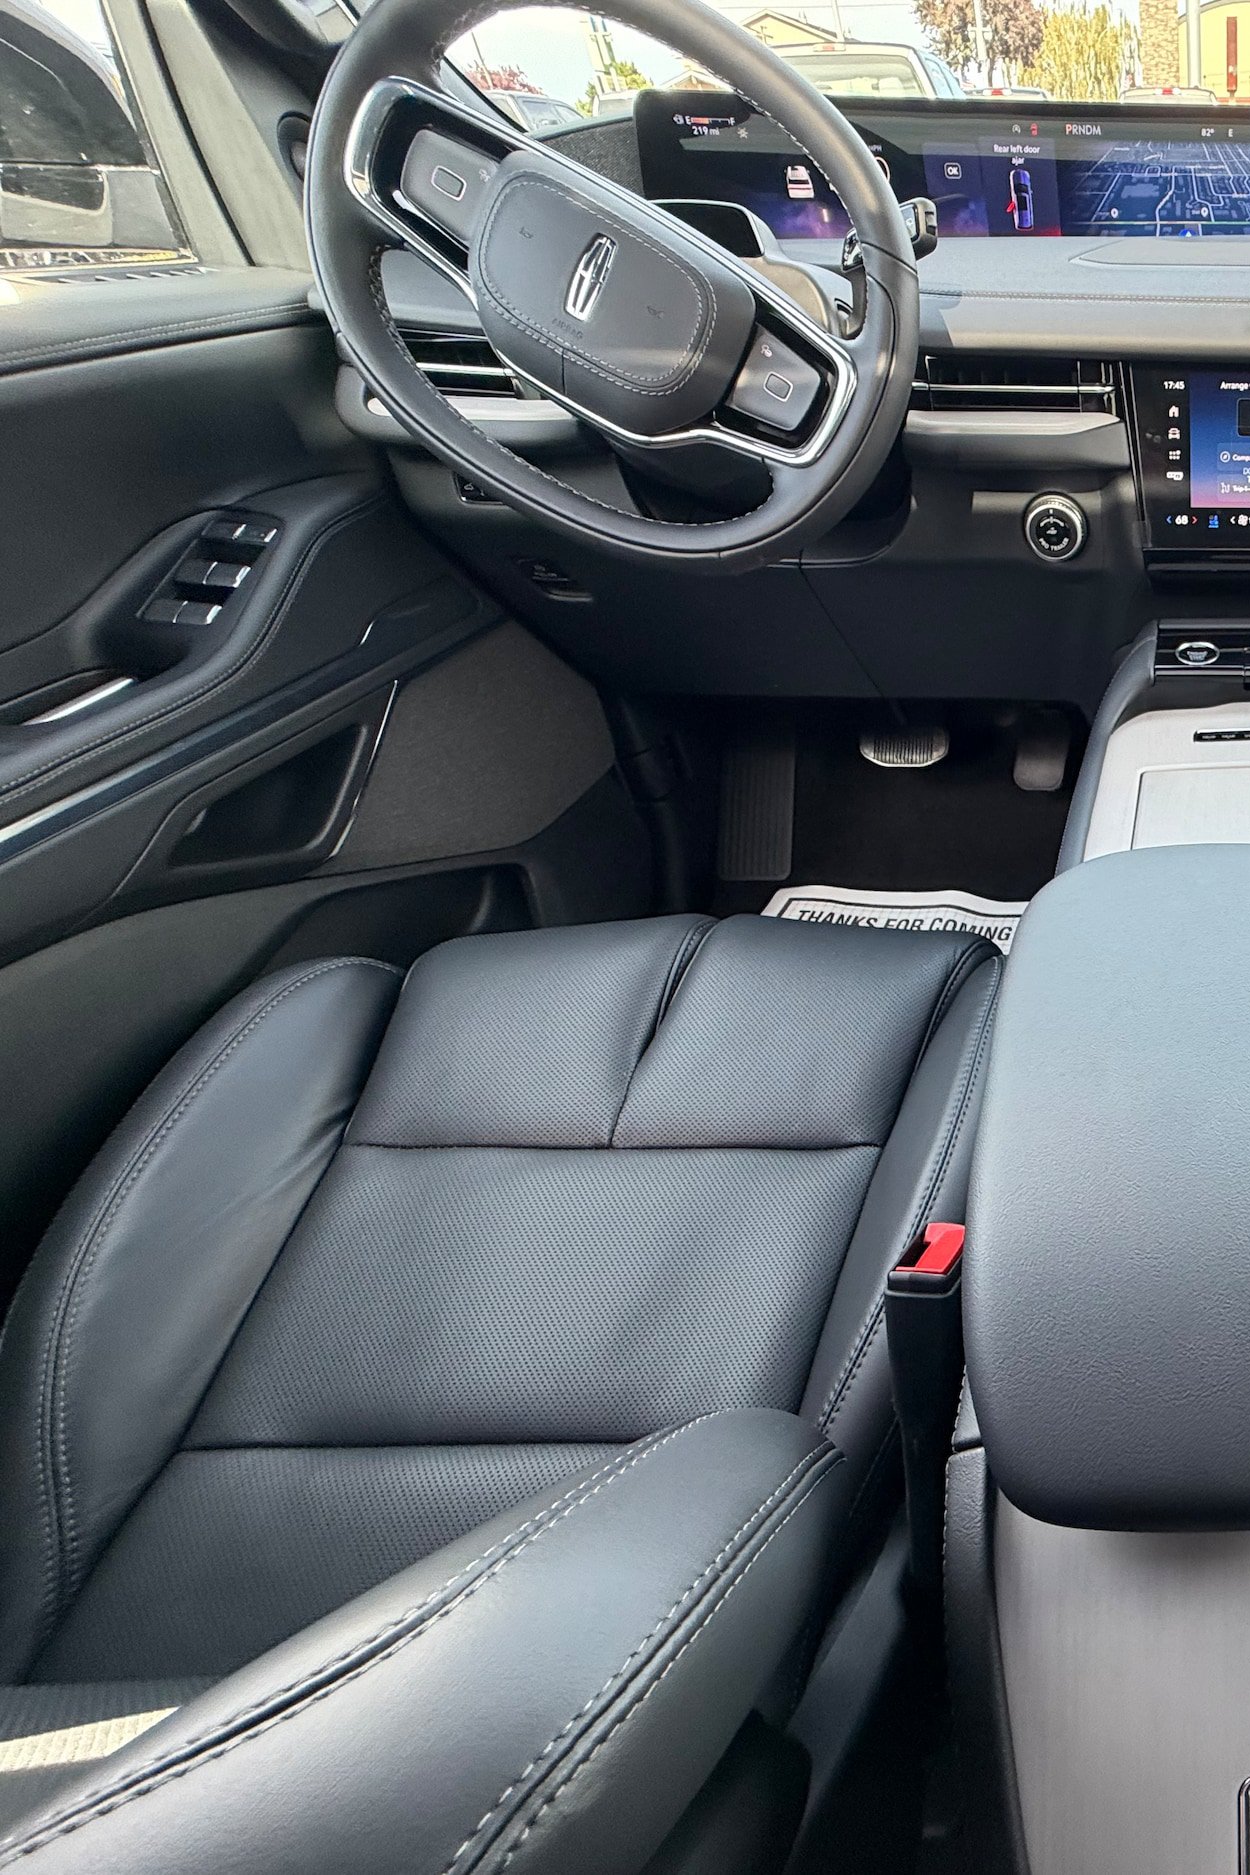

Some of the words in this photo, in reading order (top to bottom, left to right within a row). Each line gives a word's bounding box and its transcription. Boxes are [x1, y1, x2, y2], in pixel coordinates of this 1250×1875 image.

[692, 126, 708, 135] 219
[1065, 124, 1101, 136] PRNDM
[993, 144, 1010, 153] Rear
[1010, 144, 1023, 153] left
[1023, 145, 1040, 154] door
[947, 166, 959, 176] OK
[1163, 381, 1185, 390] 17:45
[1220, 381, 1248, 391] Arrange
[1175, 515, 1188, 525] 68
